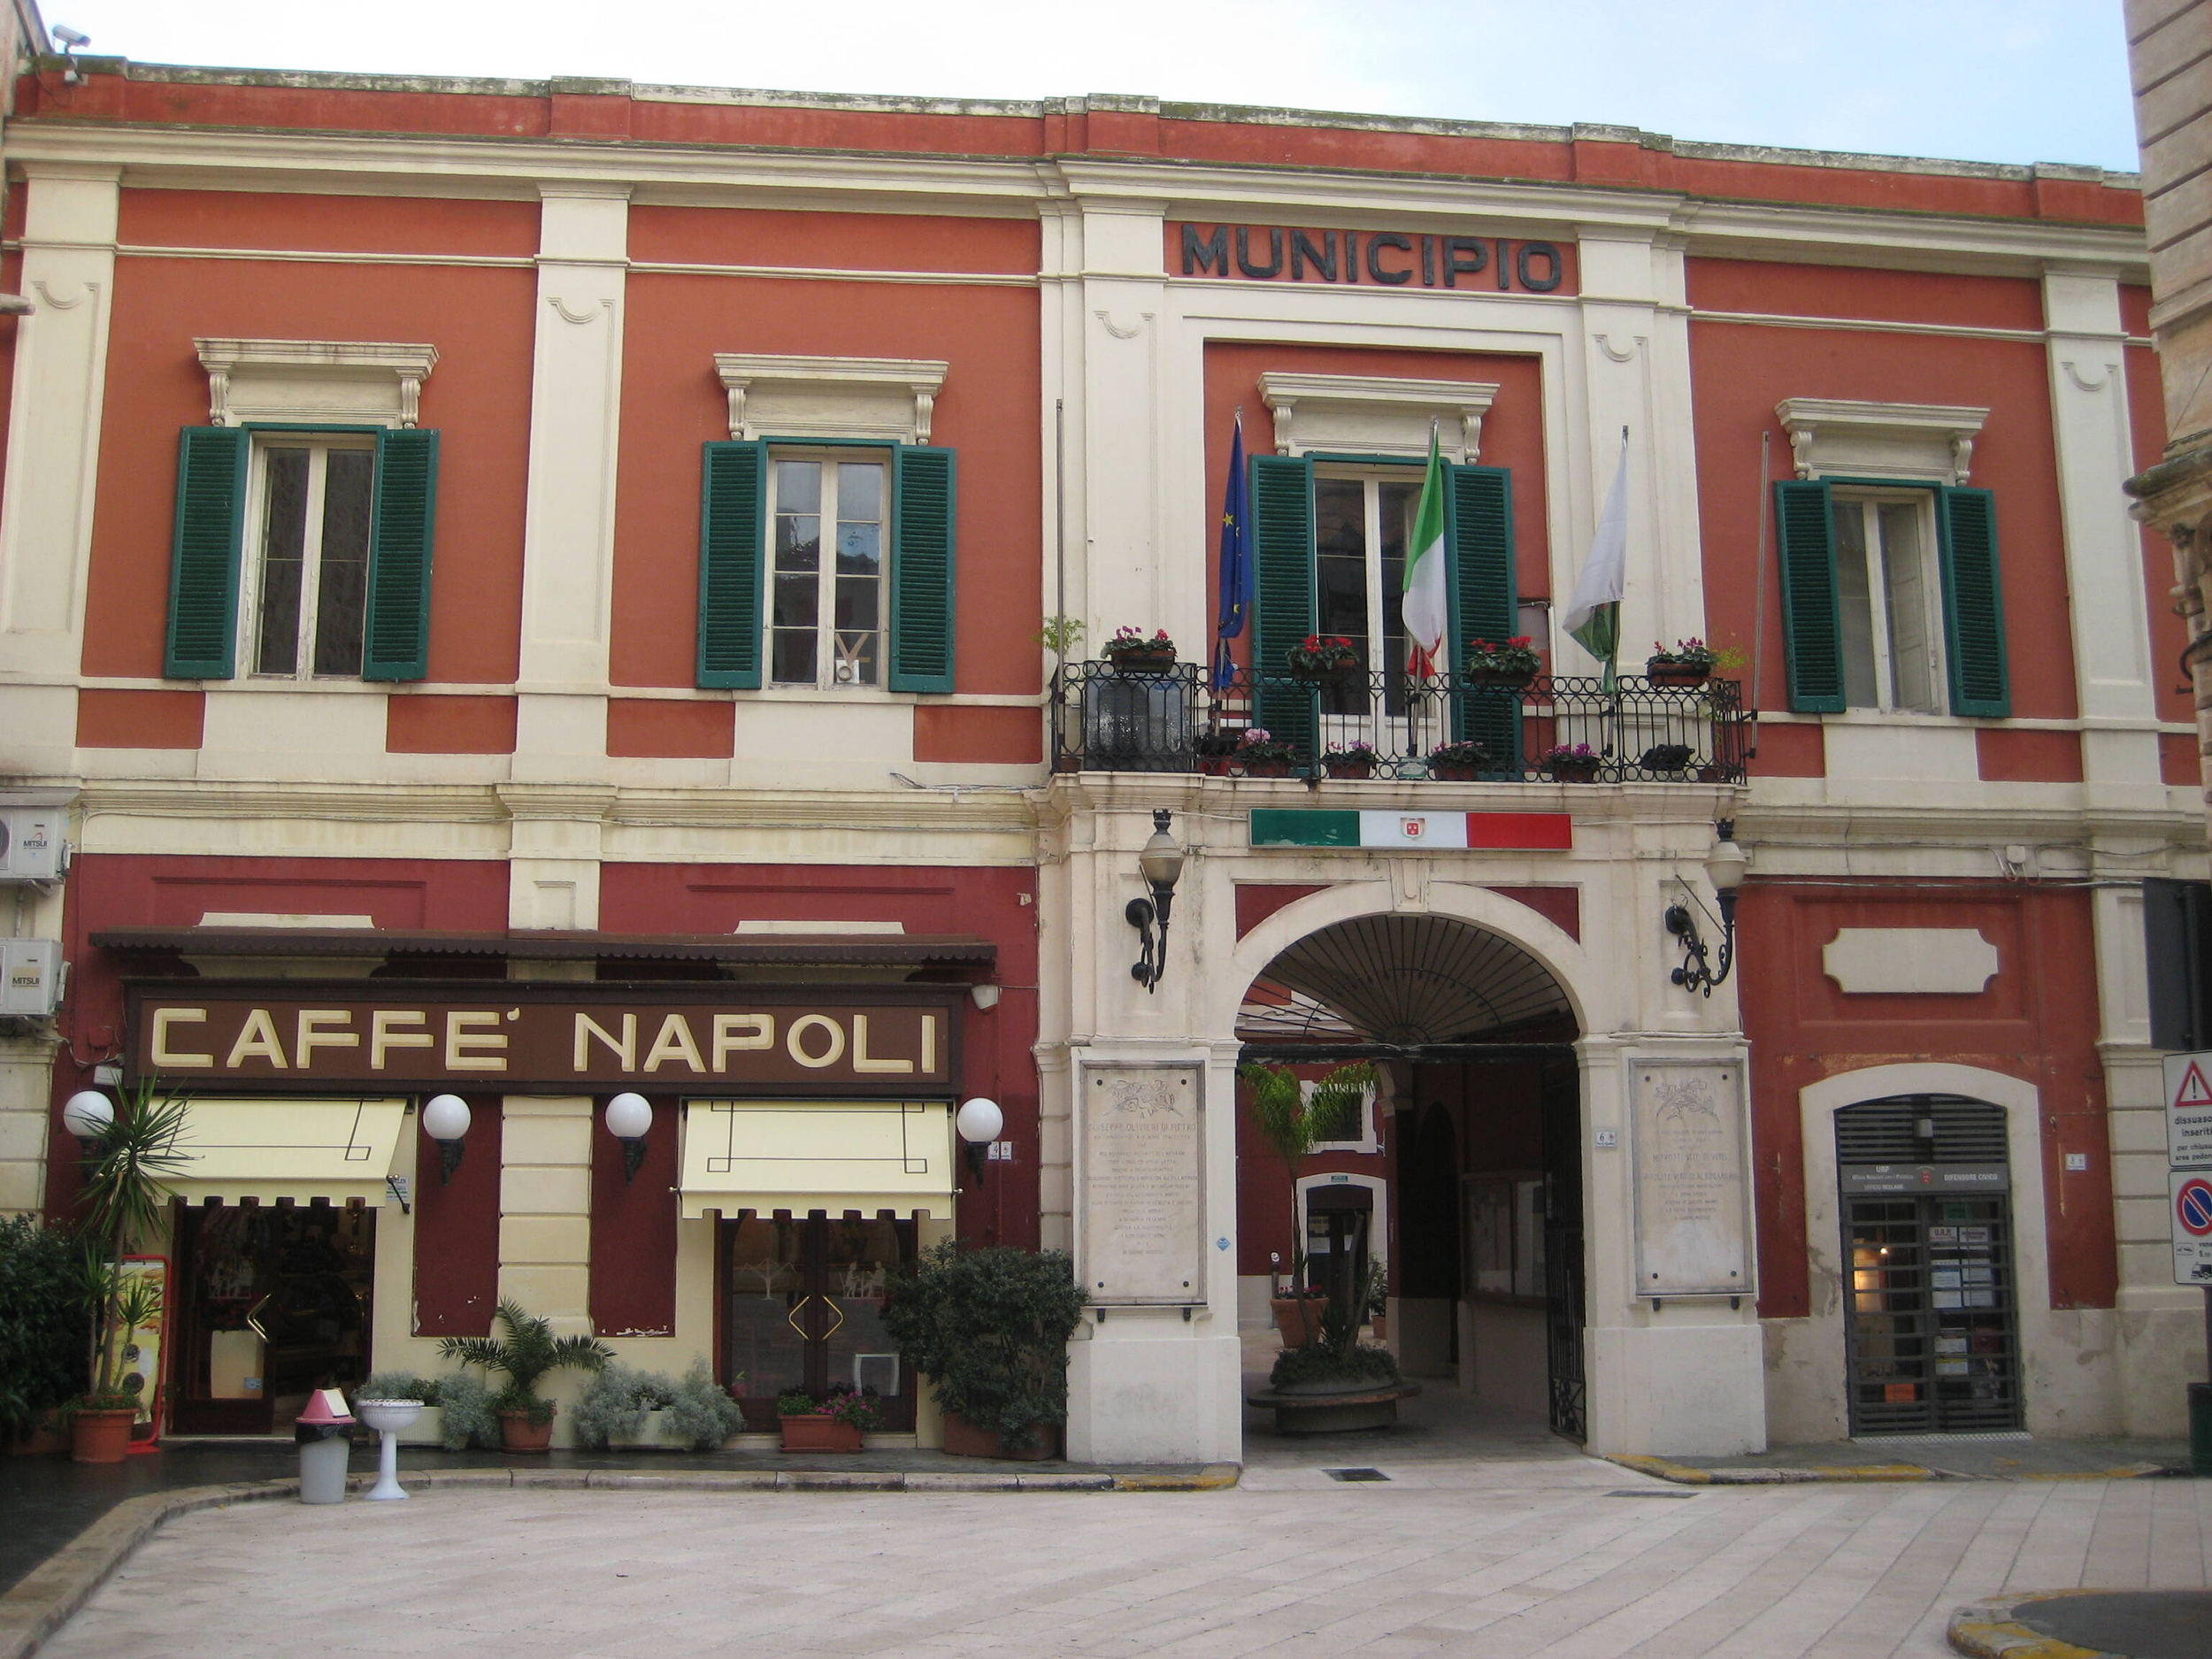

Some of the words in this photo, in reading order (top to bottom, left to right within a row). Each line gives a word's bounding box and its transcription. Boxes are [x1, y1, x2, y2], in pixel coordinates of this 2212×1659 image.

[1181, 223, 1563, 292] MUNICIPIO
[572, 1011, 936, 1073] NAPOLI
[1170, 1123, 1197, 1132] PIETRO
